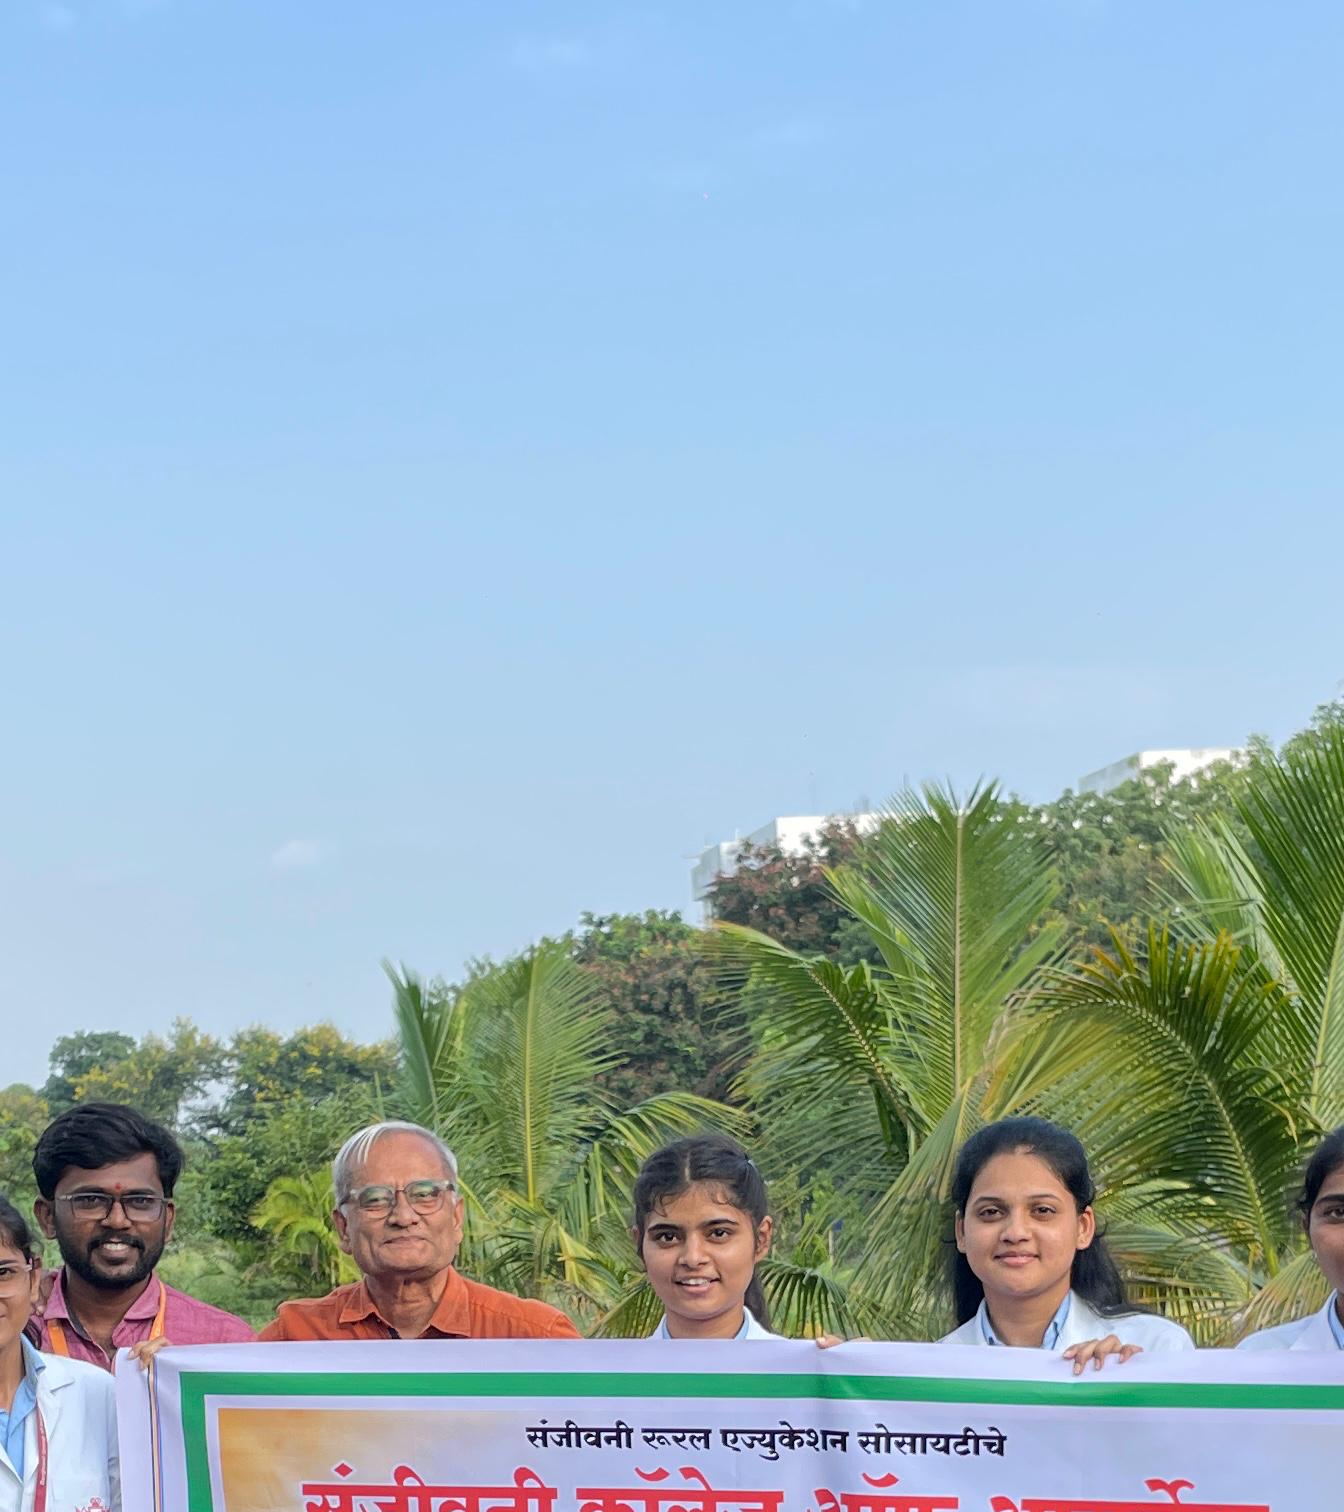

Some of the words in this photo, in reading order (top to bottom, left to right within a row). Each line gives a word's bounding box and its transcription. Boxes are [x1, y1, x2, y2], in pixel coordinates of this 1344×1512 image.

[526, 1419, 633, 1449] संजीवनी
[641, 1427, 712, 1452] रूरल
[720, 1421, 848, 1461] एज्युकेशन
[857, 1423, 1008, 1457] सोसायटीचे
